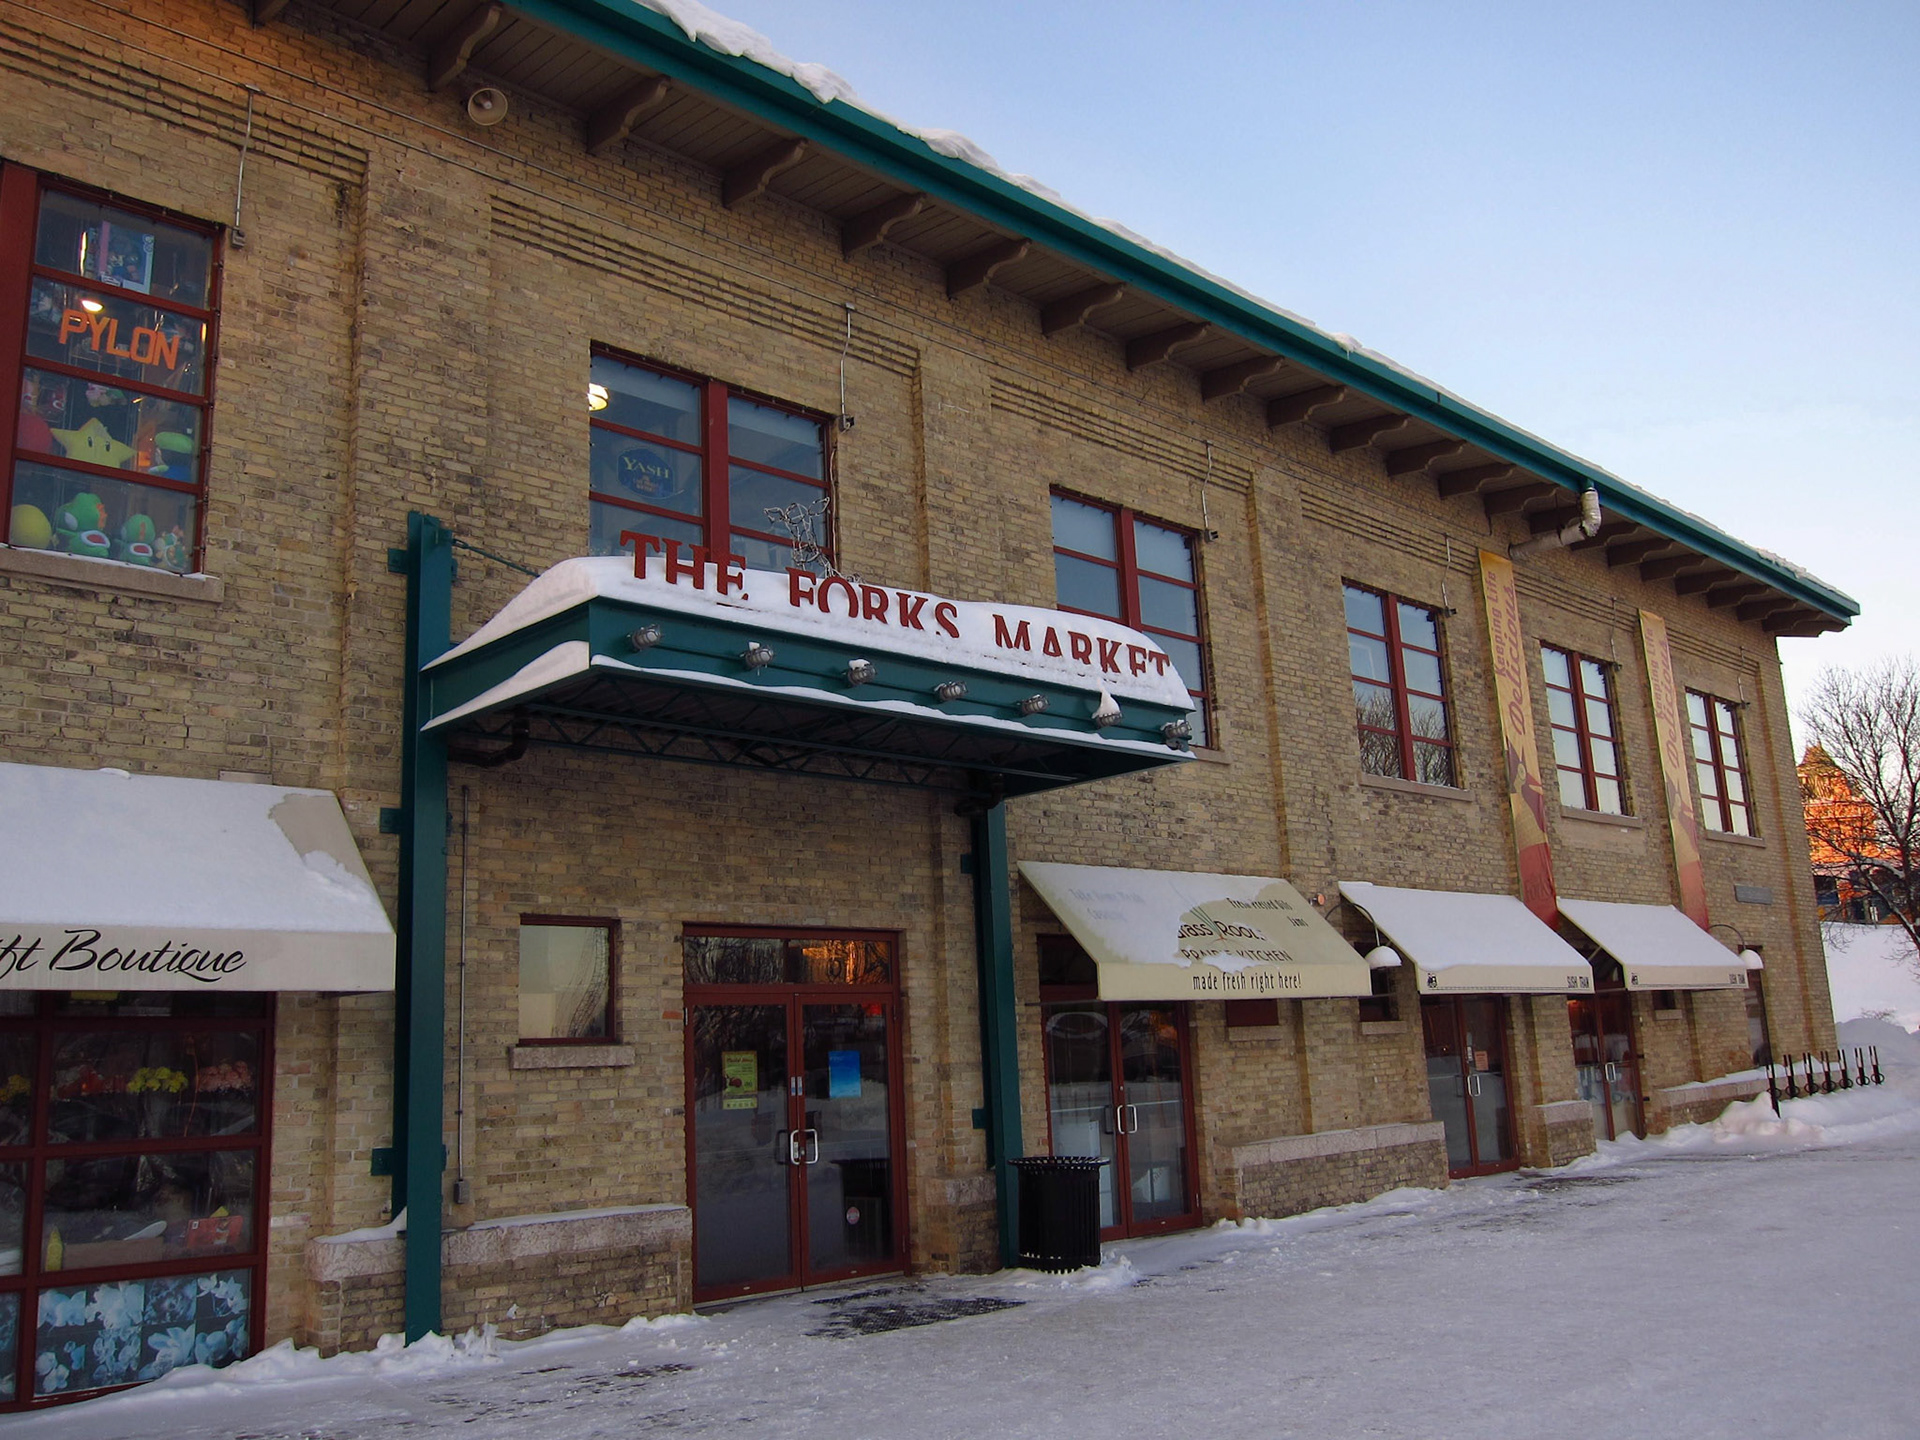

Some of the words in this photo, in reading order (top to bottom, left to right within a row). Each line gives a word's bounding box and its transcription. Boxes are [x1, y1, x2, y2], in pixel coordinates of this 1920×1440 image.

[58, 308, 180, 370] PYLON
[622, 455, 670, 479] YASH
[620, 530, 749, 601] THE
[785, 566, 961, 639] FORKS
[992, 613, 1171, 678] MARKET
[1485, 571, 1500, 602] Life
[1491, 607, 1507, 680] Keeping
[1503, 580, 1526, 736] Delicious
[1659, 640, 1680, 770] Delicious
[0, 934, 45, 980] ft
[49, 929, 248, 983] Boutique
[1192, 972, 1218, 990] made
[1222, 971, 1246, 991] fresh
[1250, 972, 1275, 993] right
[1278, 971, 1302, 989] here!
[1235, 949, 1294, 961] KITCHEN
